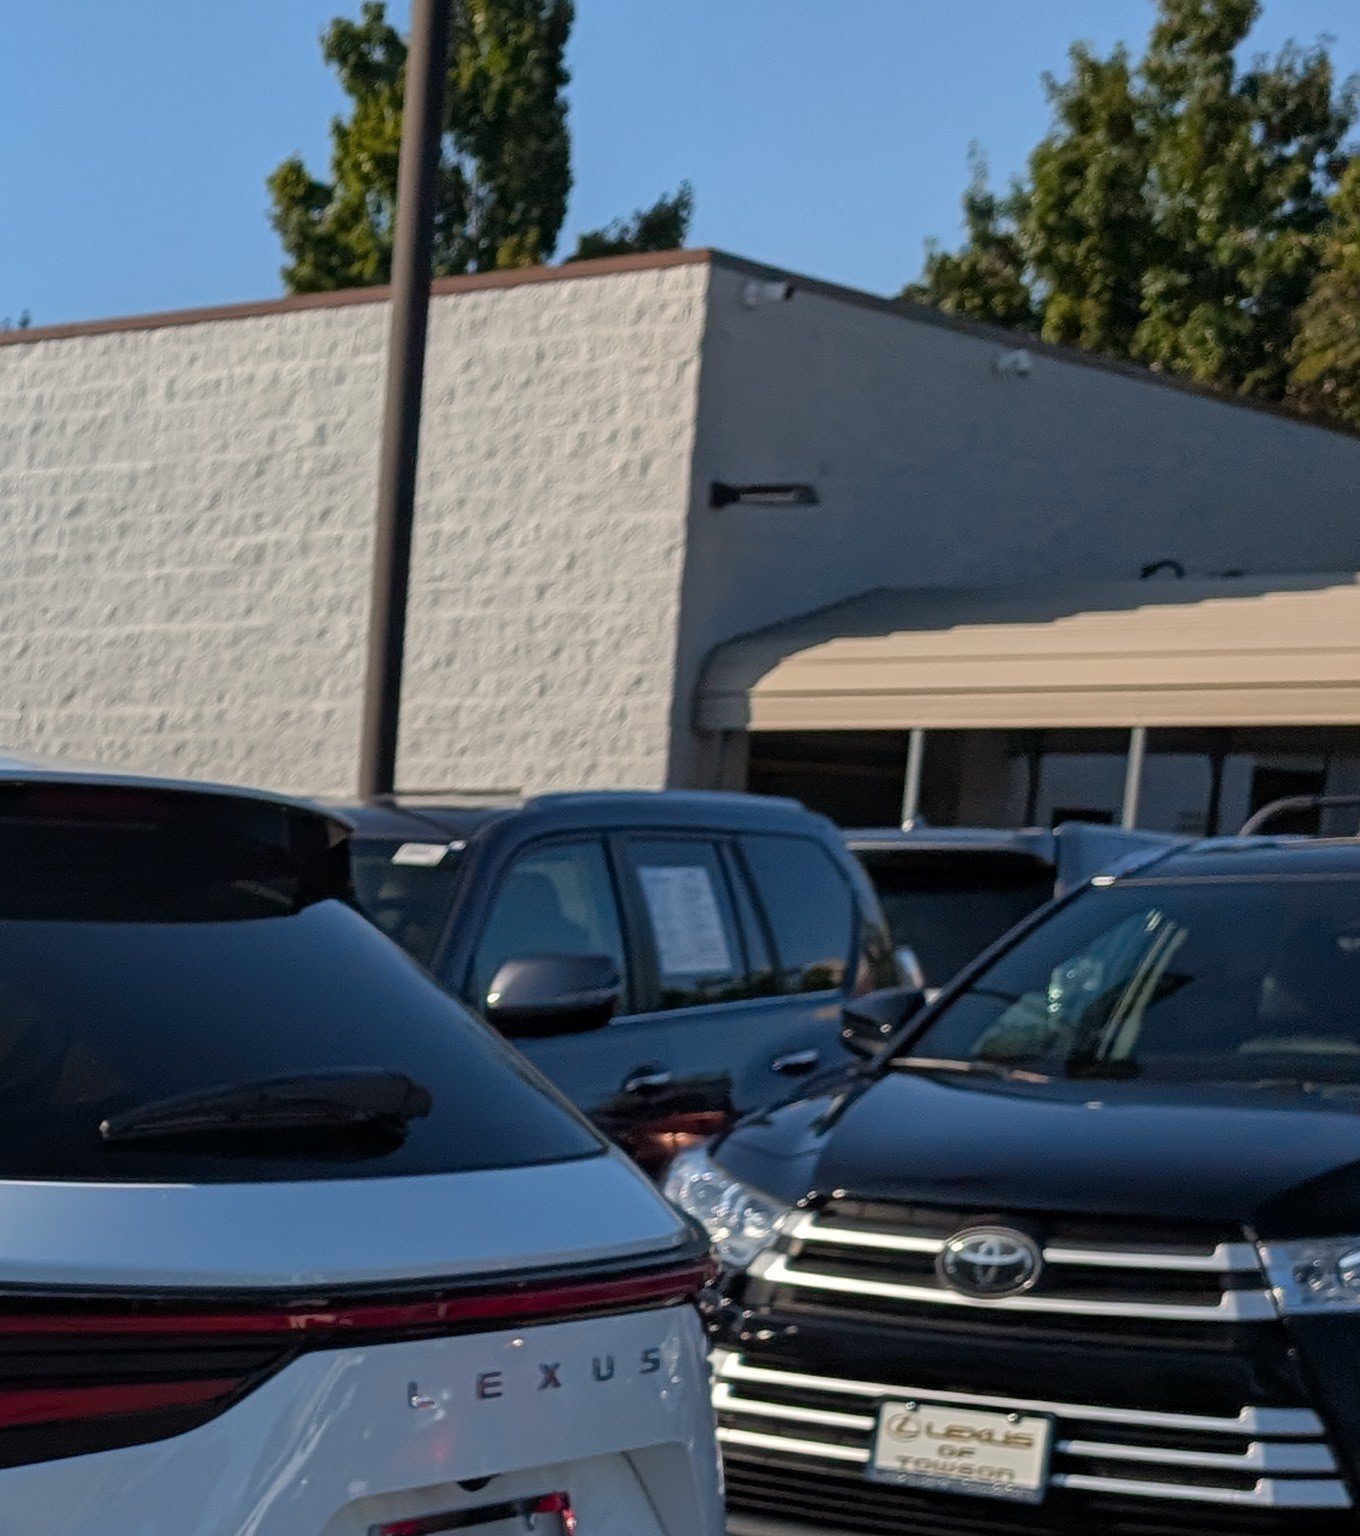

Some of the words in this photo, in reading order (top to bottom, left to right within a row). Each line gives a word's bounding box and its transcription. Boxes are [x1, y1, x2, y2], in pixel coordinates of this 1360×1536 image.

[407, 1347, 661, 1410] LEXUS
[925, 1420, 1035, 1450] LEXUS
[936, 1443, 976, 1459] OF
